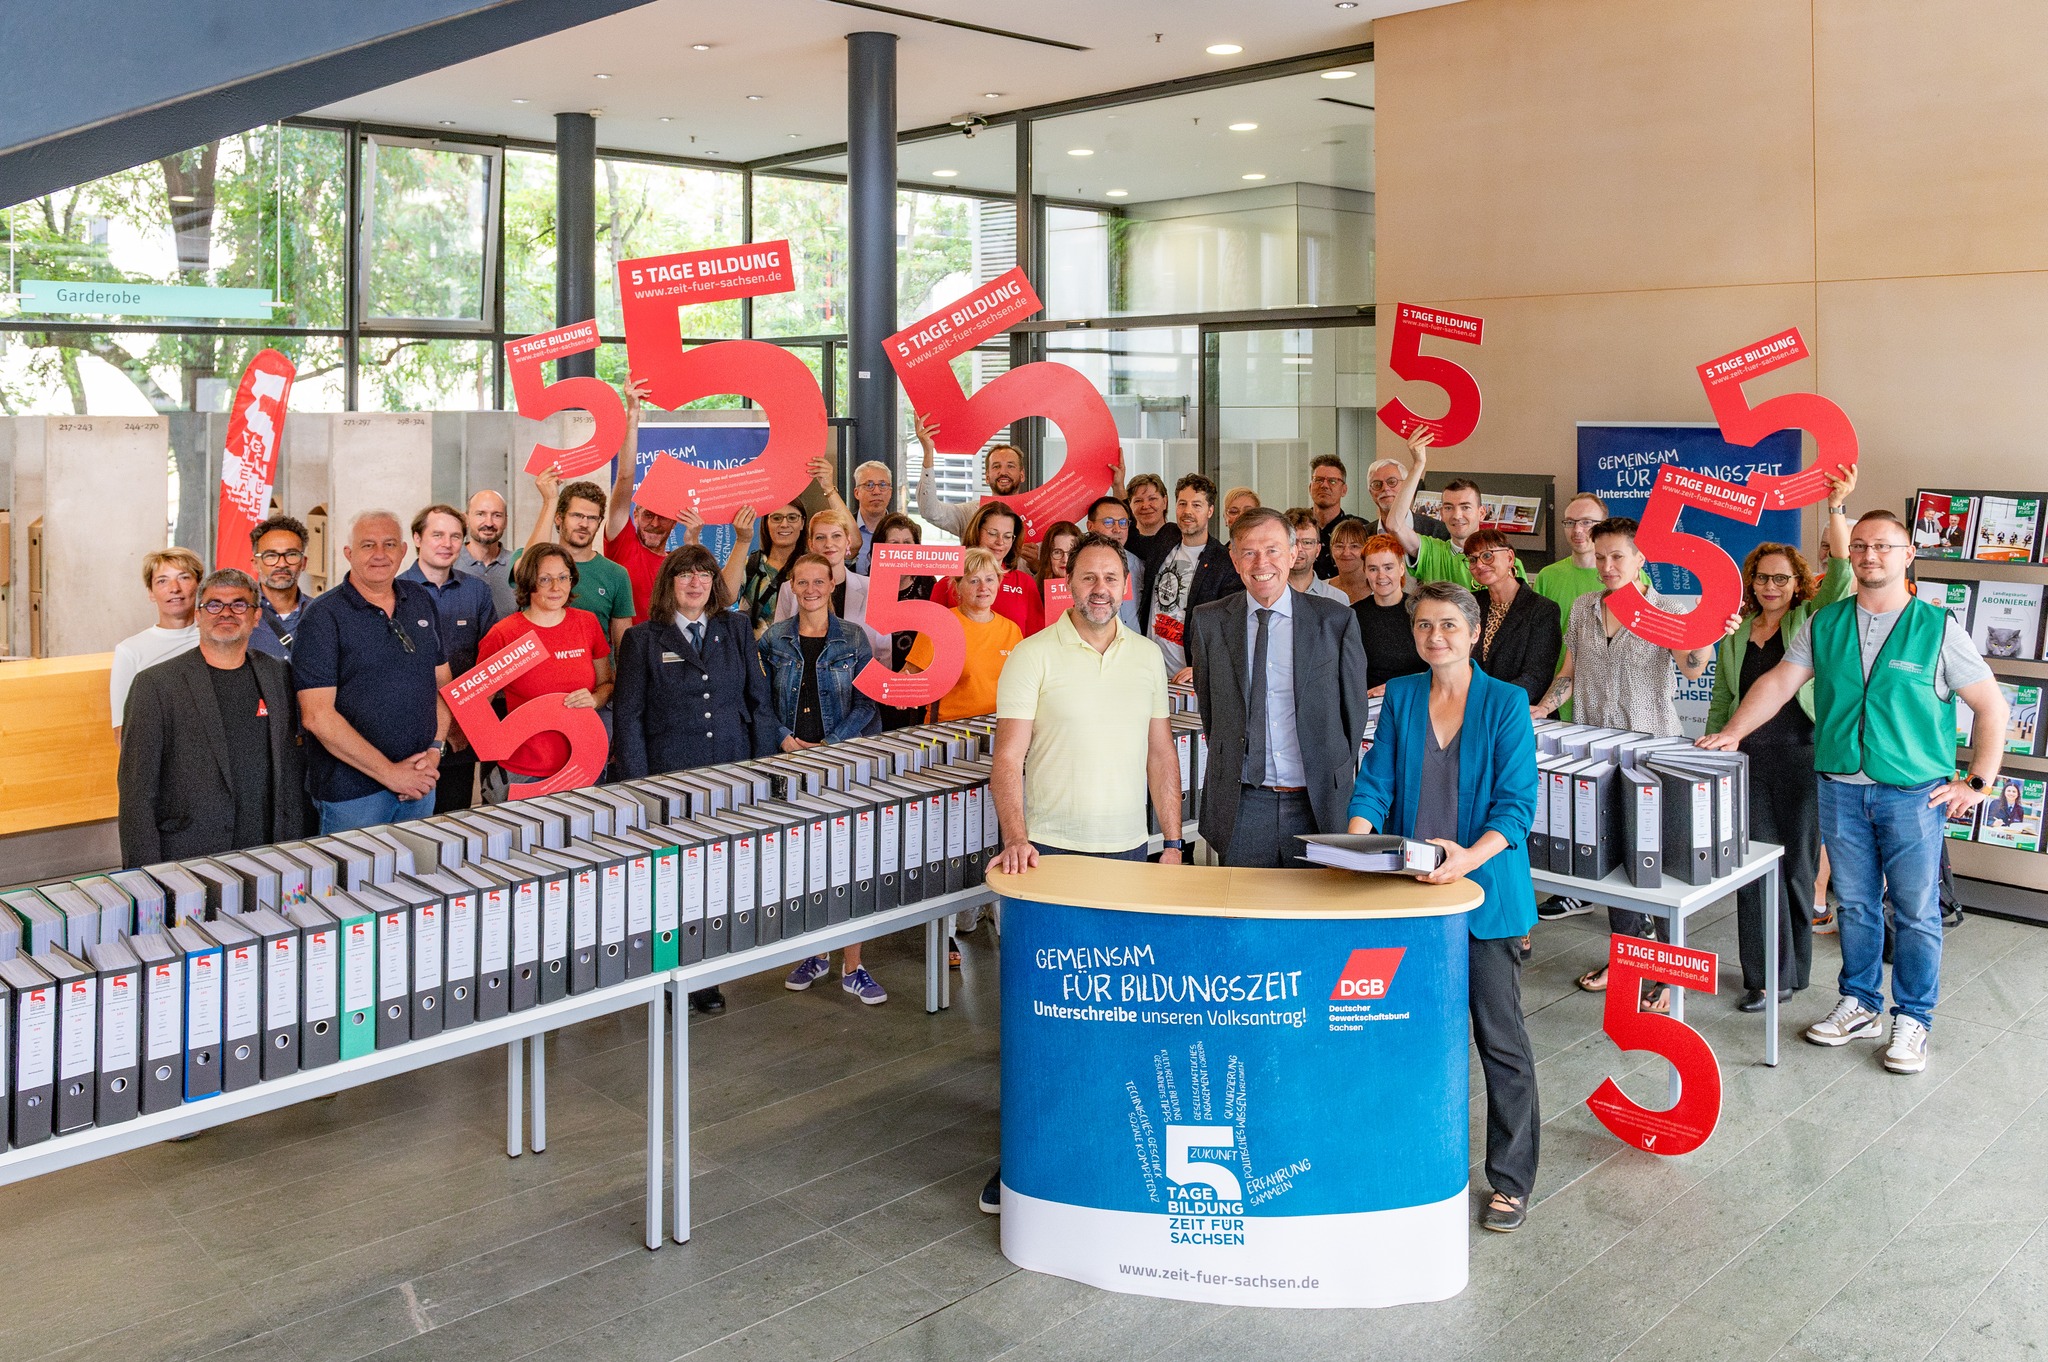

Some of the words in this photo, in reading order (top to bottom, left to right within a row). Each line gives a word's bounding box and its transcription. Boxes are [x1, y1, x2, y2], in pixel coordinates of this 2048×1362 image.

[631, 270, 643, 285] 5
[646, 263, 694, 284] TAGE
[698, 252, 780, 278] BILDUNG
[634, 271, 782, 299] www.zeit-fuer-sachsen.de
[57, 289, 141, 304] Garderobe
[897, 342, 910, 358] 5
[909, 318, 952, 350] TAGE
[951, 280, 1022, 328] BILDUNG
[1403, 309, 1409, 317] 5
[1411, 310, 1434, 322] TAGE
[1436, 315, 1477, 331] BILDUNG
[906, 295, 1028, 369] www.zeit-fuer-sachsen.de
[1402, 320, 1476, 338] www.zeit-fuer-sachsen.de
[512, 346, 520, 356] 5
[521, 338, 547, 354] TAGE
[548, 326, 593, 346] BILDUNG
[515, 336, 594, 364] www.zeit-fuer-sachsen.de
[1706, 368, 1714, 378] 5
[1714, 355, 1744, 375] TAGE
[1745, 335, 1796, 362] BILDUNG
[1711, 347, 1799, 386] www.zeit-fuer-sachsen.de
[572, 416, 595, 424] 325-35
[1598, 449, 1679, 470] GEMEINSAM
[1617, 467, 1651, 487] FÜR
[1664, 472, 1673, 483] 5
[1674, 474, 1702, 492] TAGE
[1705, 483, 1756, 508] BILDUNG
[1662, 484, 1752, 516] www.zeit-fuer-sachsen.de
[879, 550, 887, 560] 5
[888, 550, 914, 561] TAGE
[915, 550, 960, 562] BILDUNG
[879, 561, 959, 570] www.zeit-fuer-sachsen.de
[1003, 584, 1023, 594] EVG
[1051, 584, 1057, 593] 5
[1982, 597, 2037, 607] ABONNIEREN!
[450, 688, 460, 699] 5
[458, 670, 489, 693] TAGE
[487, 639, 536, 675] BILDUNG
[458, 650, 540, 706] www.zeit-fuer-sachsen.de
[1580, 780, 1588, 788] 5
[1644, 787, 1653, 796] 5
[688, 848, 696, 857] 5
[609, 866, 618, 876] 5
[635, 858, 644, 868] 5
[550, 882, 560, 891] 5
[580, 874, 588, 883] 5
[489, 890, 500, 901] 5
[521, 883, 530, 893] 5
[455, 897, 466, 907] 5
[387, 914, 398, 924] 5
[423, 906, 434, 916] 5
[352, 924, 364, 934] 5
[276, 939, 288, 950] 5
[314, 932, 325, 944] 5
[198, 956, 210, 967] 5
[235, 948, 248, 959] 5
[1035, 944, 1155, 970] GEMEINSAM
[1617, 943, 1625, 954] 5
[1627, 944, 1655, 961] TAGE
[1658, 950, 1710, 972] BILDUNG
[156, 964, 170, 976] 5
[1617, 958, 1709, 983] www.zeit-fuer-sachsen.de
[72, 980, 86, 993] 5
[113, 975, 127, 987] 5
[1062, 969, 1112, 1002] FÜR
[1122, 970, 1302, 1002] BILDUNGSZEIT
[1340, 978, 1385, 997] DGB
[31, 989, 45, 1002] 5
[1033, 1001, 1137, 1024] Unterschreibe
[1141, 1010, 1203, 1026] unseren
[1207, 1009, 1307, 1029] Volksantrag!
[1329, 1005, 1371, 1013] Deutscher
[1329, 1011, 1410, 1022] Gewerkschaftsbund
[1329, 1024, 1364, 1032] Sachsen
[1160, 1049, 1175, 1089] KULTURELLE
[1169, 1089, 1183, 1121] BILDUNG
[1190, 1044, 1201, 1121] GESELLSCHAFTLICHES
[1224, 1054, 1238, 1120] QUALIFIZIERUNG
[1200, 1069, 1213, 1121] ENGAGEMENT
[1160, 1099, 1172, 1123] TIPPS
[1235, 1092, 1247, 1128] WISSEN
[1125, 1080, 1153, 1137] TECHNISCHES
[1147, 1136, 1163, 1179] GESCHICK
[1128, 1112, 1143, 1142] SOZIALE
[1190, 1147, 1238, 1161] ZUKUNFT
[1235, 1130, 1254, 1180] POLITISCHES
[1165, 1124, 1242, 1201] 5
[1135, 1144, 1160, 1203] KOMPETENZ
[1245, 1158, 1312, 1195] ERFAHRUNG
[1167, 1187, 1213, 1200] TAGE
[1250, 1180, 1293, 1207] SAMMELN
[1168, 1202, 1244, 1215] BILDUNG
[1169, 1218, 1206, 1231] ZEIT
[1211, 1216, 1244, 1231] FÜR
[1170, 1232, 1245, 1245] SACHSEN
[1119, 1263, 1320, 1290] www.zeit-fuer-sachsen.de
